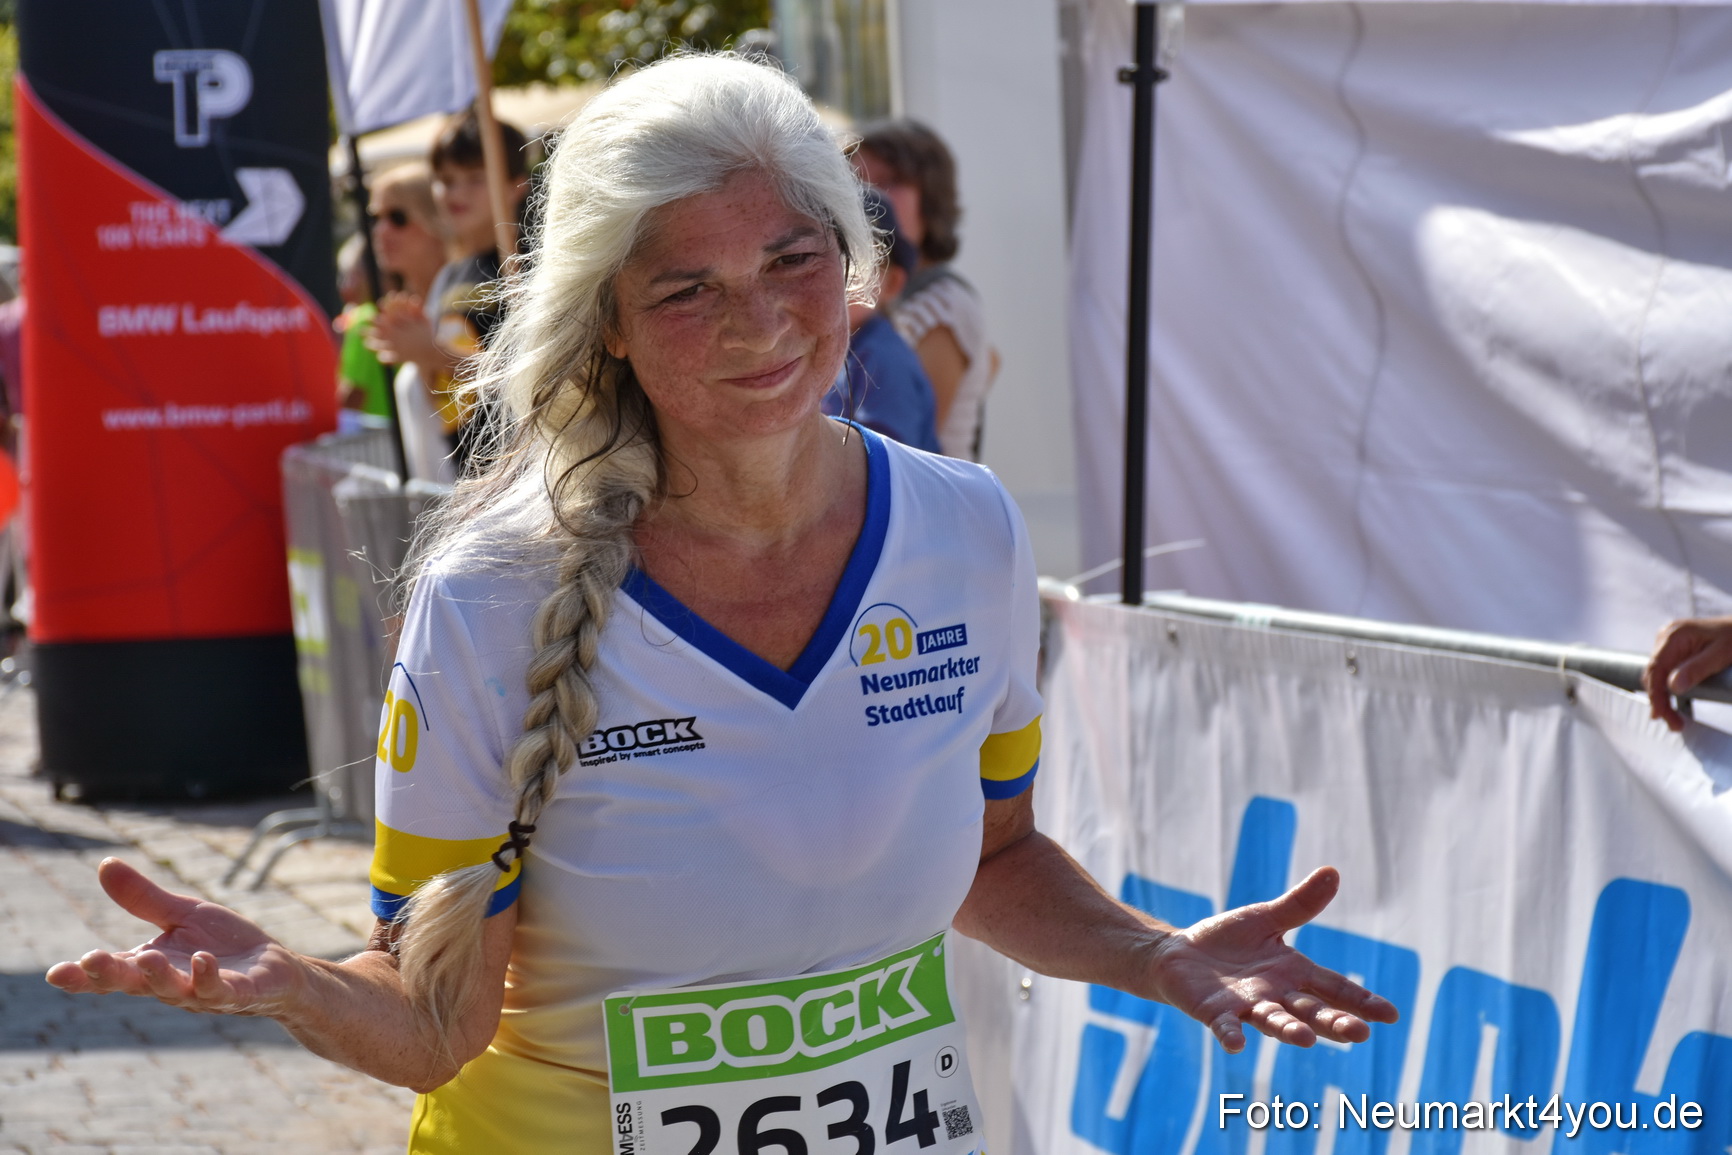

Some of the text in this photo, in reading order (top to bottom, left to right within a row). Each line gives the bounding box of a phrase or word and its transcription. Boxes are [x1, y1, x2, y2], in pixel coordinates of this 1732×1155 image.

[98, 304, 178, 337] BMW
[858, 617, 965, 666] 20 JAHRE
[860, 655, 980, 695] Neumarkter
[865, 686, 965, 727] Stadtlauf
[376, 689, 419, 773] 20
[577, 716, 703, 759] BOCK
[580, 742, 706, 767] inspired by smart concepts
[637, 957, 925, 1075] BOCK
[941, 1053, 953, 1072] D
[636, 1100, 646, 1151] ZEITMESSUNG
[661, 1059, 941, 1155] 2634
